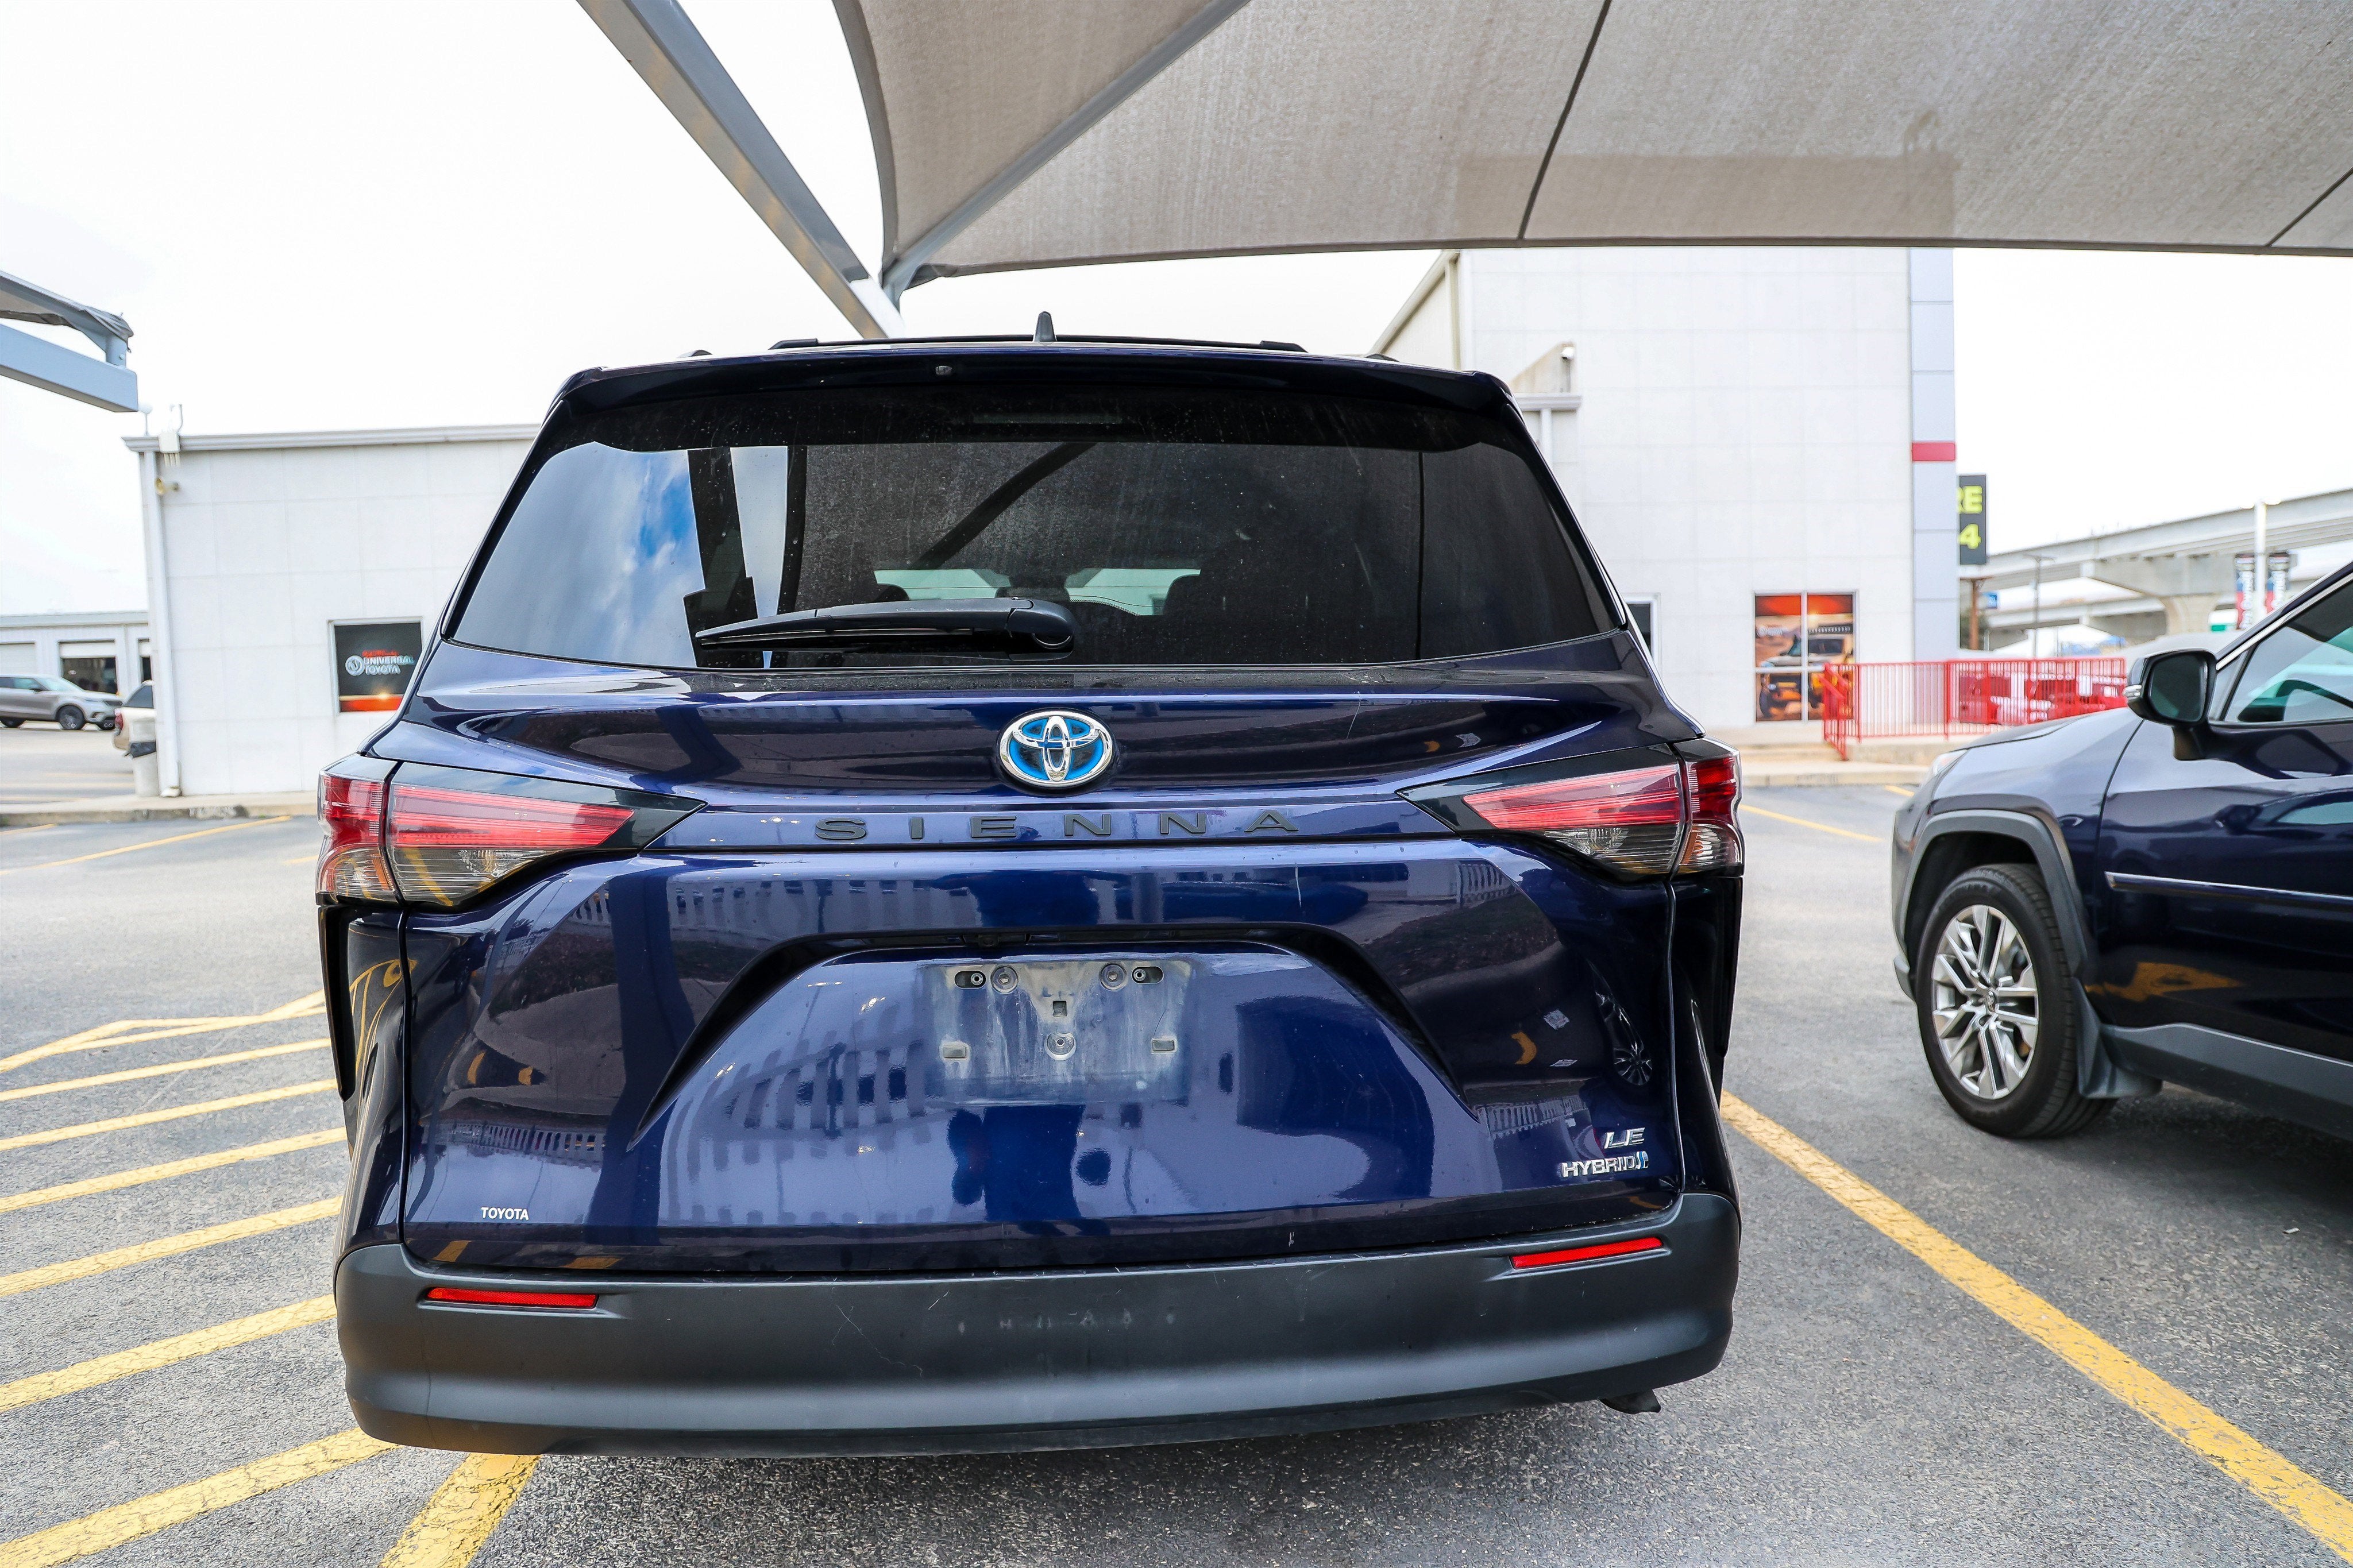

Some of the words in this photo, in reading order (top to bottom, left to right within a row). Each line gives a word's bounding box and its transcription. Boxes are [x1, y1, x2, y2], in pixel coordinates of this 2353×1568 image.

[365, 665, 401, 675] TOYOTA
[815, 809, 1299, 840] SIENNA
[1603, 1127, 1645, 1149] LE
[1561, 1155, 1637, 1177] HYBRID
[481, 1206, 529, 1221] TOYOTA
